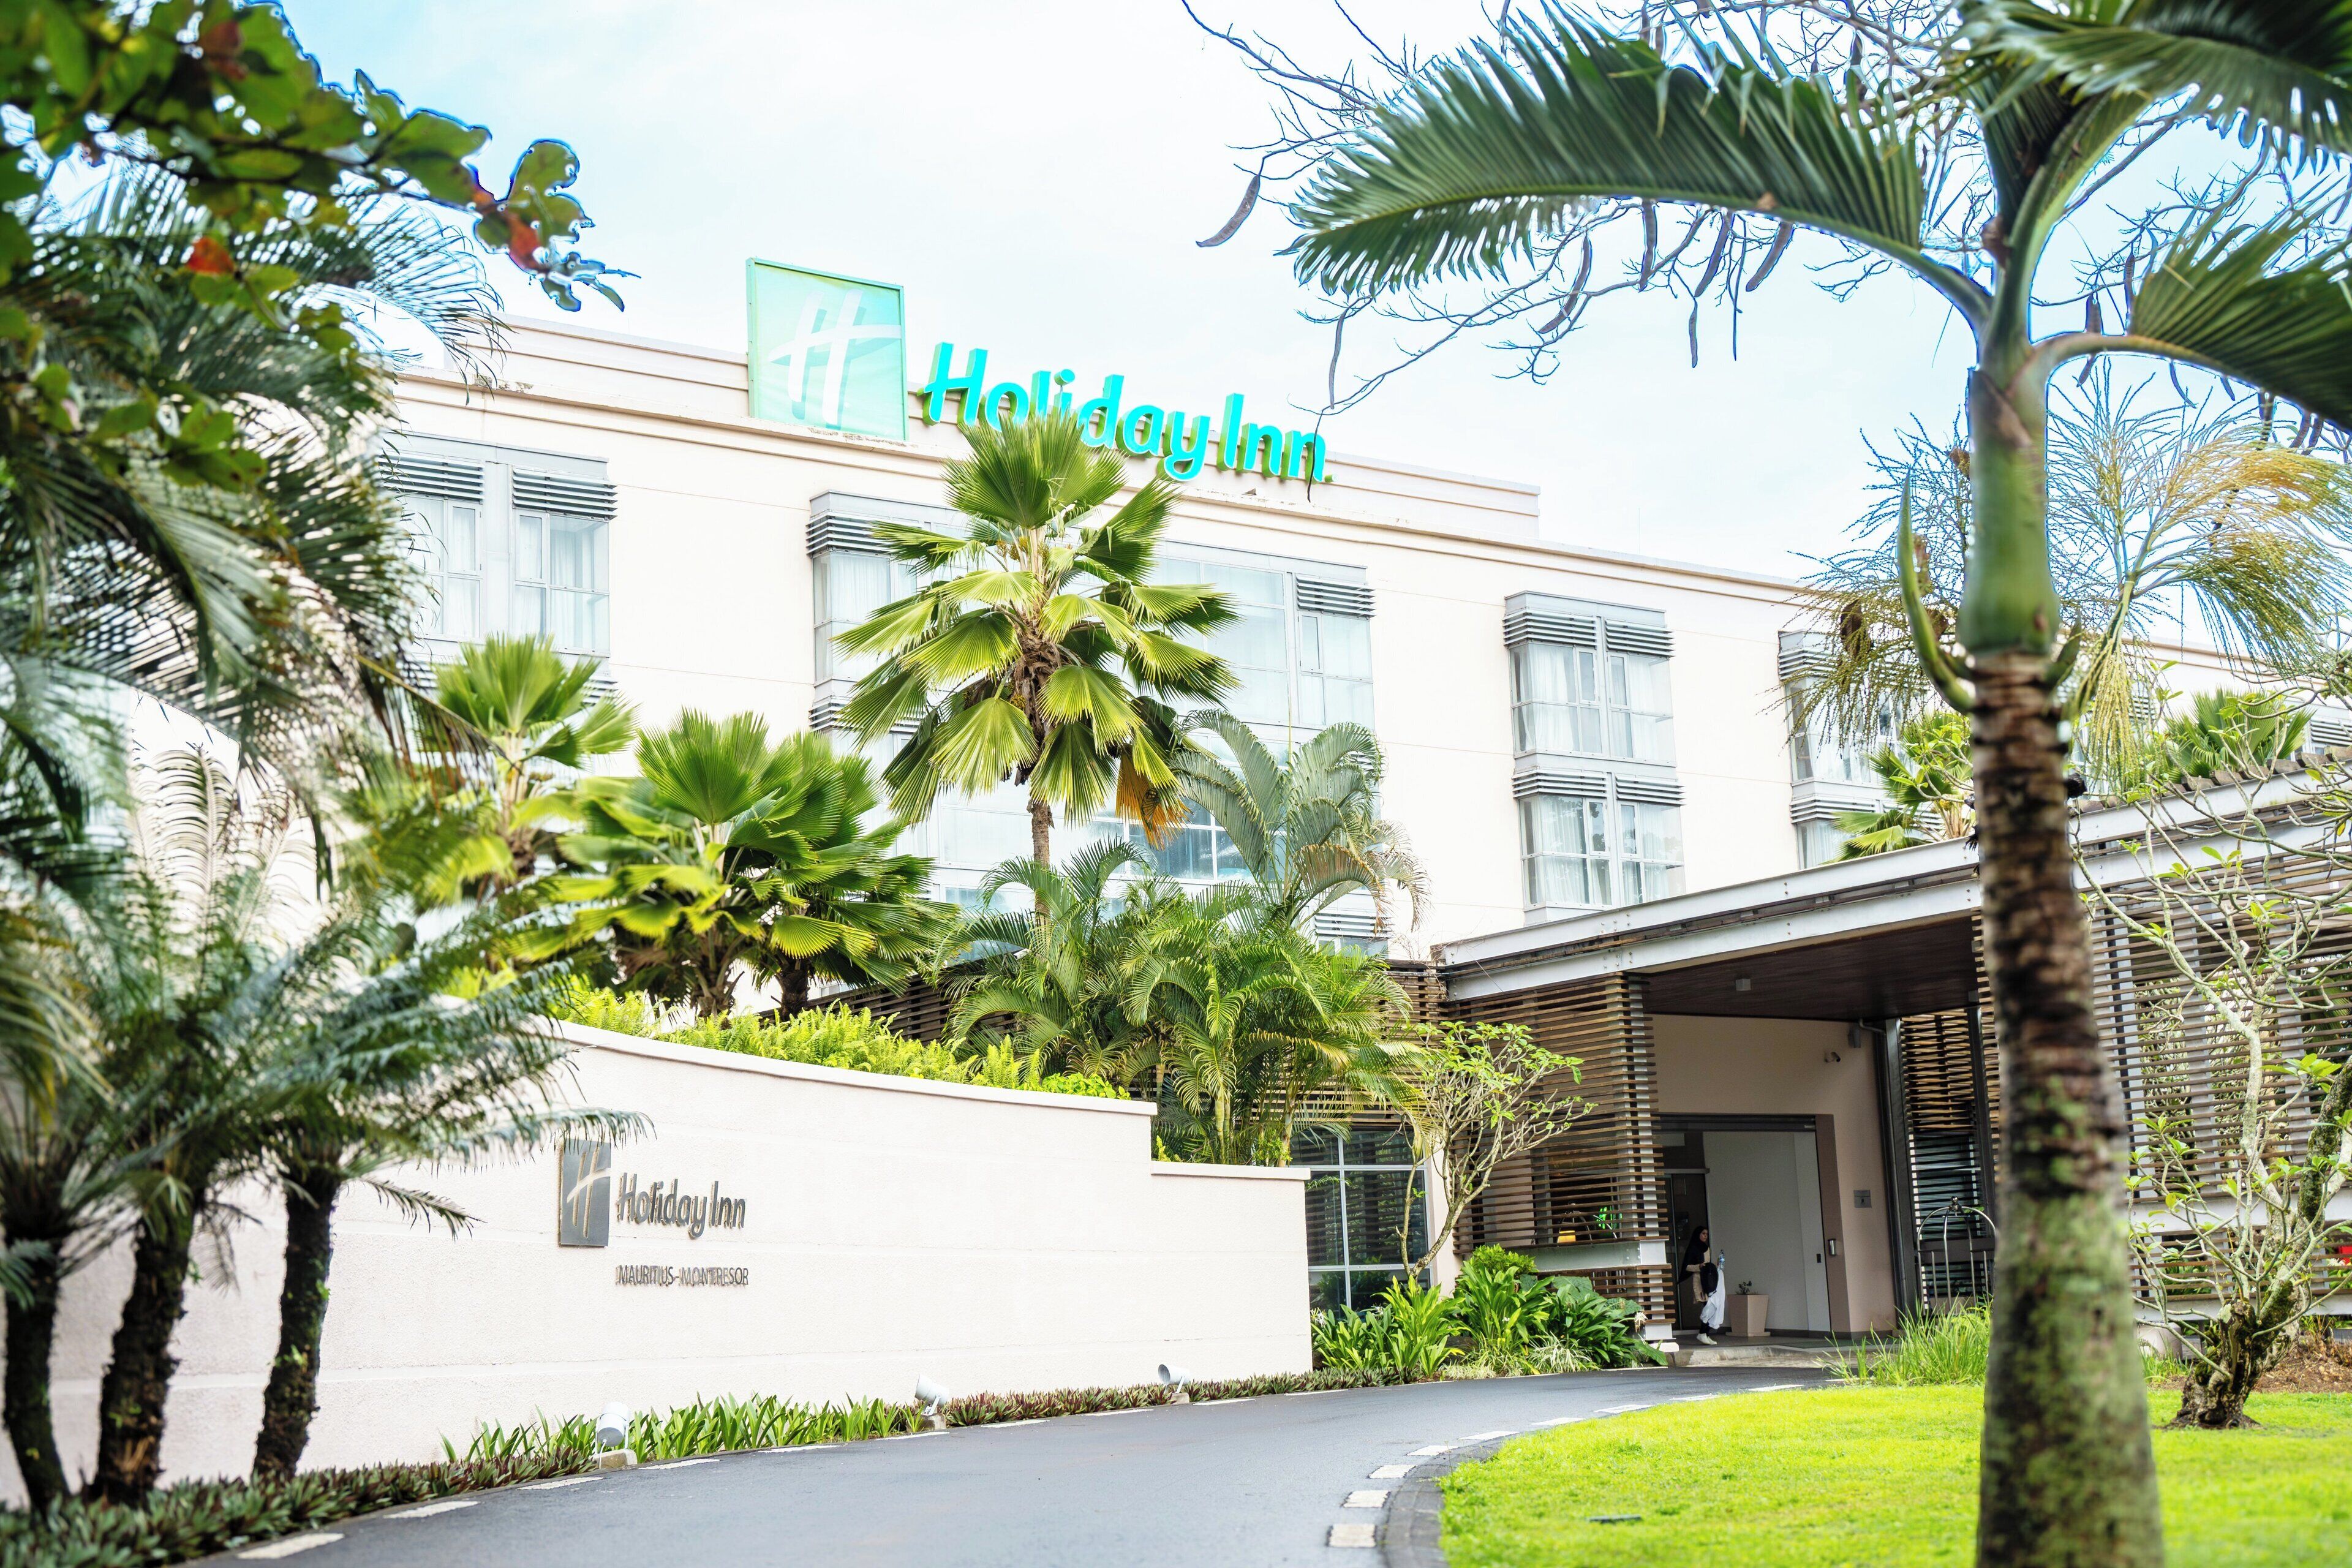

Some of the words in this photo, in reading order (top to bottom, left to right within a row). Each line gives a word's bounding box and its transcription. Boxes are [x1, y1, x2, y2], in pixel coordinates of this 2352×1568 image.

[917, 342, 1210, 482] Holiday
[616, 1172, 707, 1239] Holiday
[709, 1180, 746, 1228] Inn
